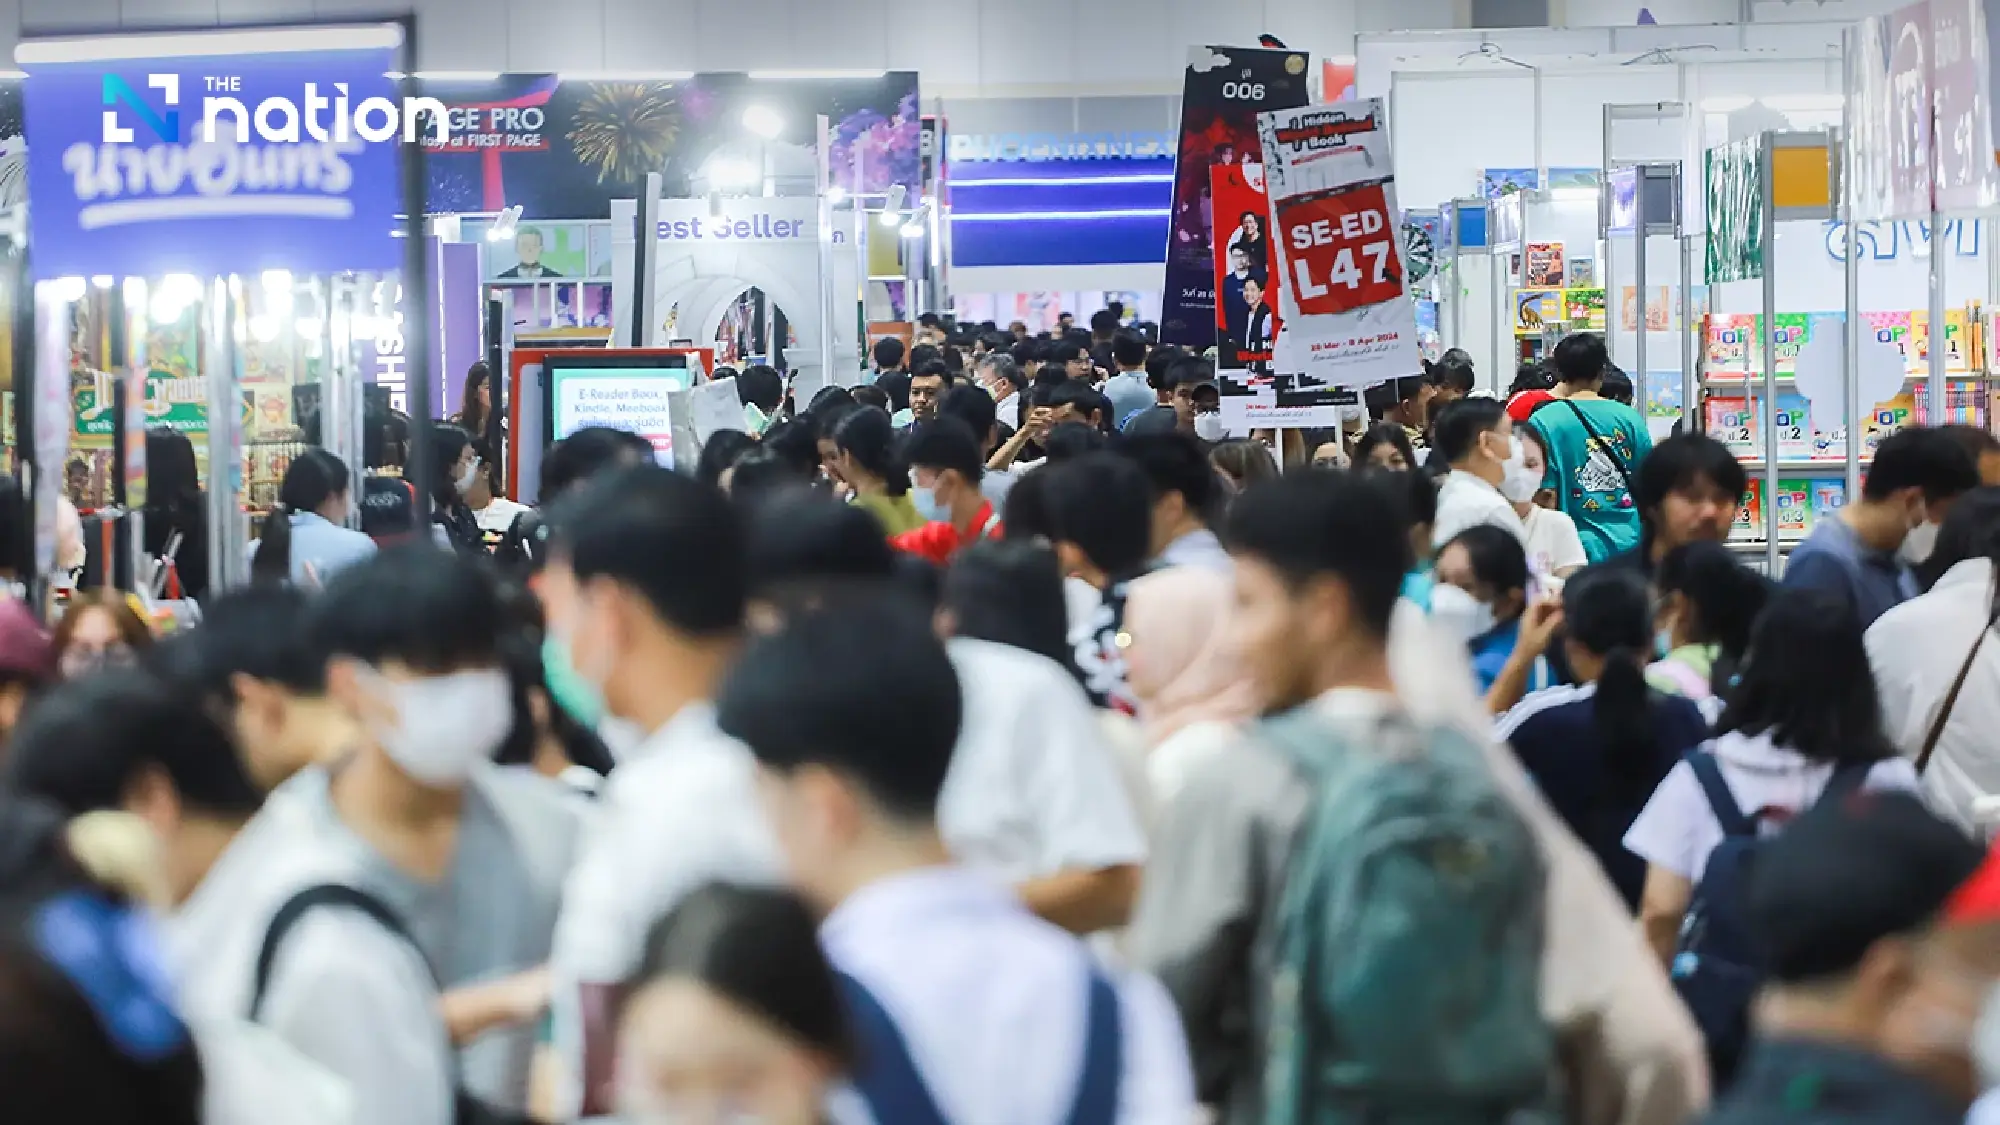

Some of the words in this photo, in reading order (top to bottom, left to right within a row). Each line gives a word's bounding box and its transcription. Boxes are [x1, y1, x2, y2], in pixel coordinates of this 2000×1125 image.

[1223, 82, 1265, 101] 006
[490, 107, 546, 130] PRO
[468, 134, 503, 147] FIRST
[506, 134, 542, 147] PAGE
[632, 213, 703, 240] est
[1290, 208, 1383, 250] SE-ED
[1293, 240, 1390, 300] L47
[1773, 325, 1804, 343] OP
[1917, 322, 1958, 340] TP
[578, 388, 629, 400] E-Reader
[574, 403, 613, 415] Kindle,
[616, 403, 667, 414] Meebook
[1775, 408, 1805, 427] OP
[1777, 491, 1807, 508] OP
